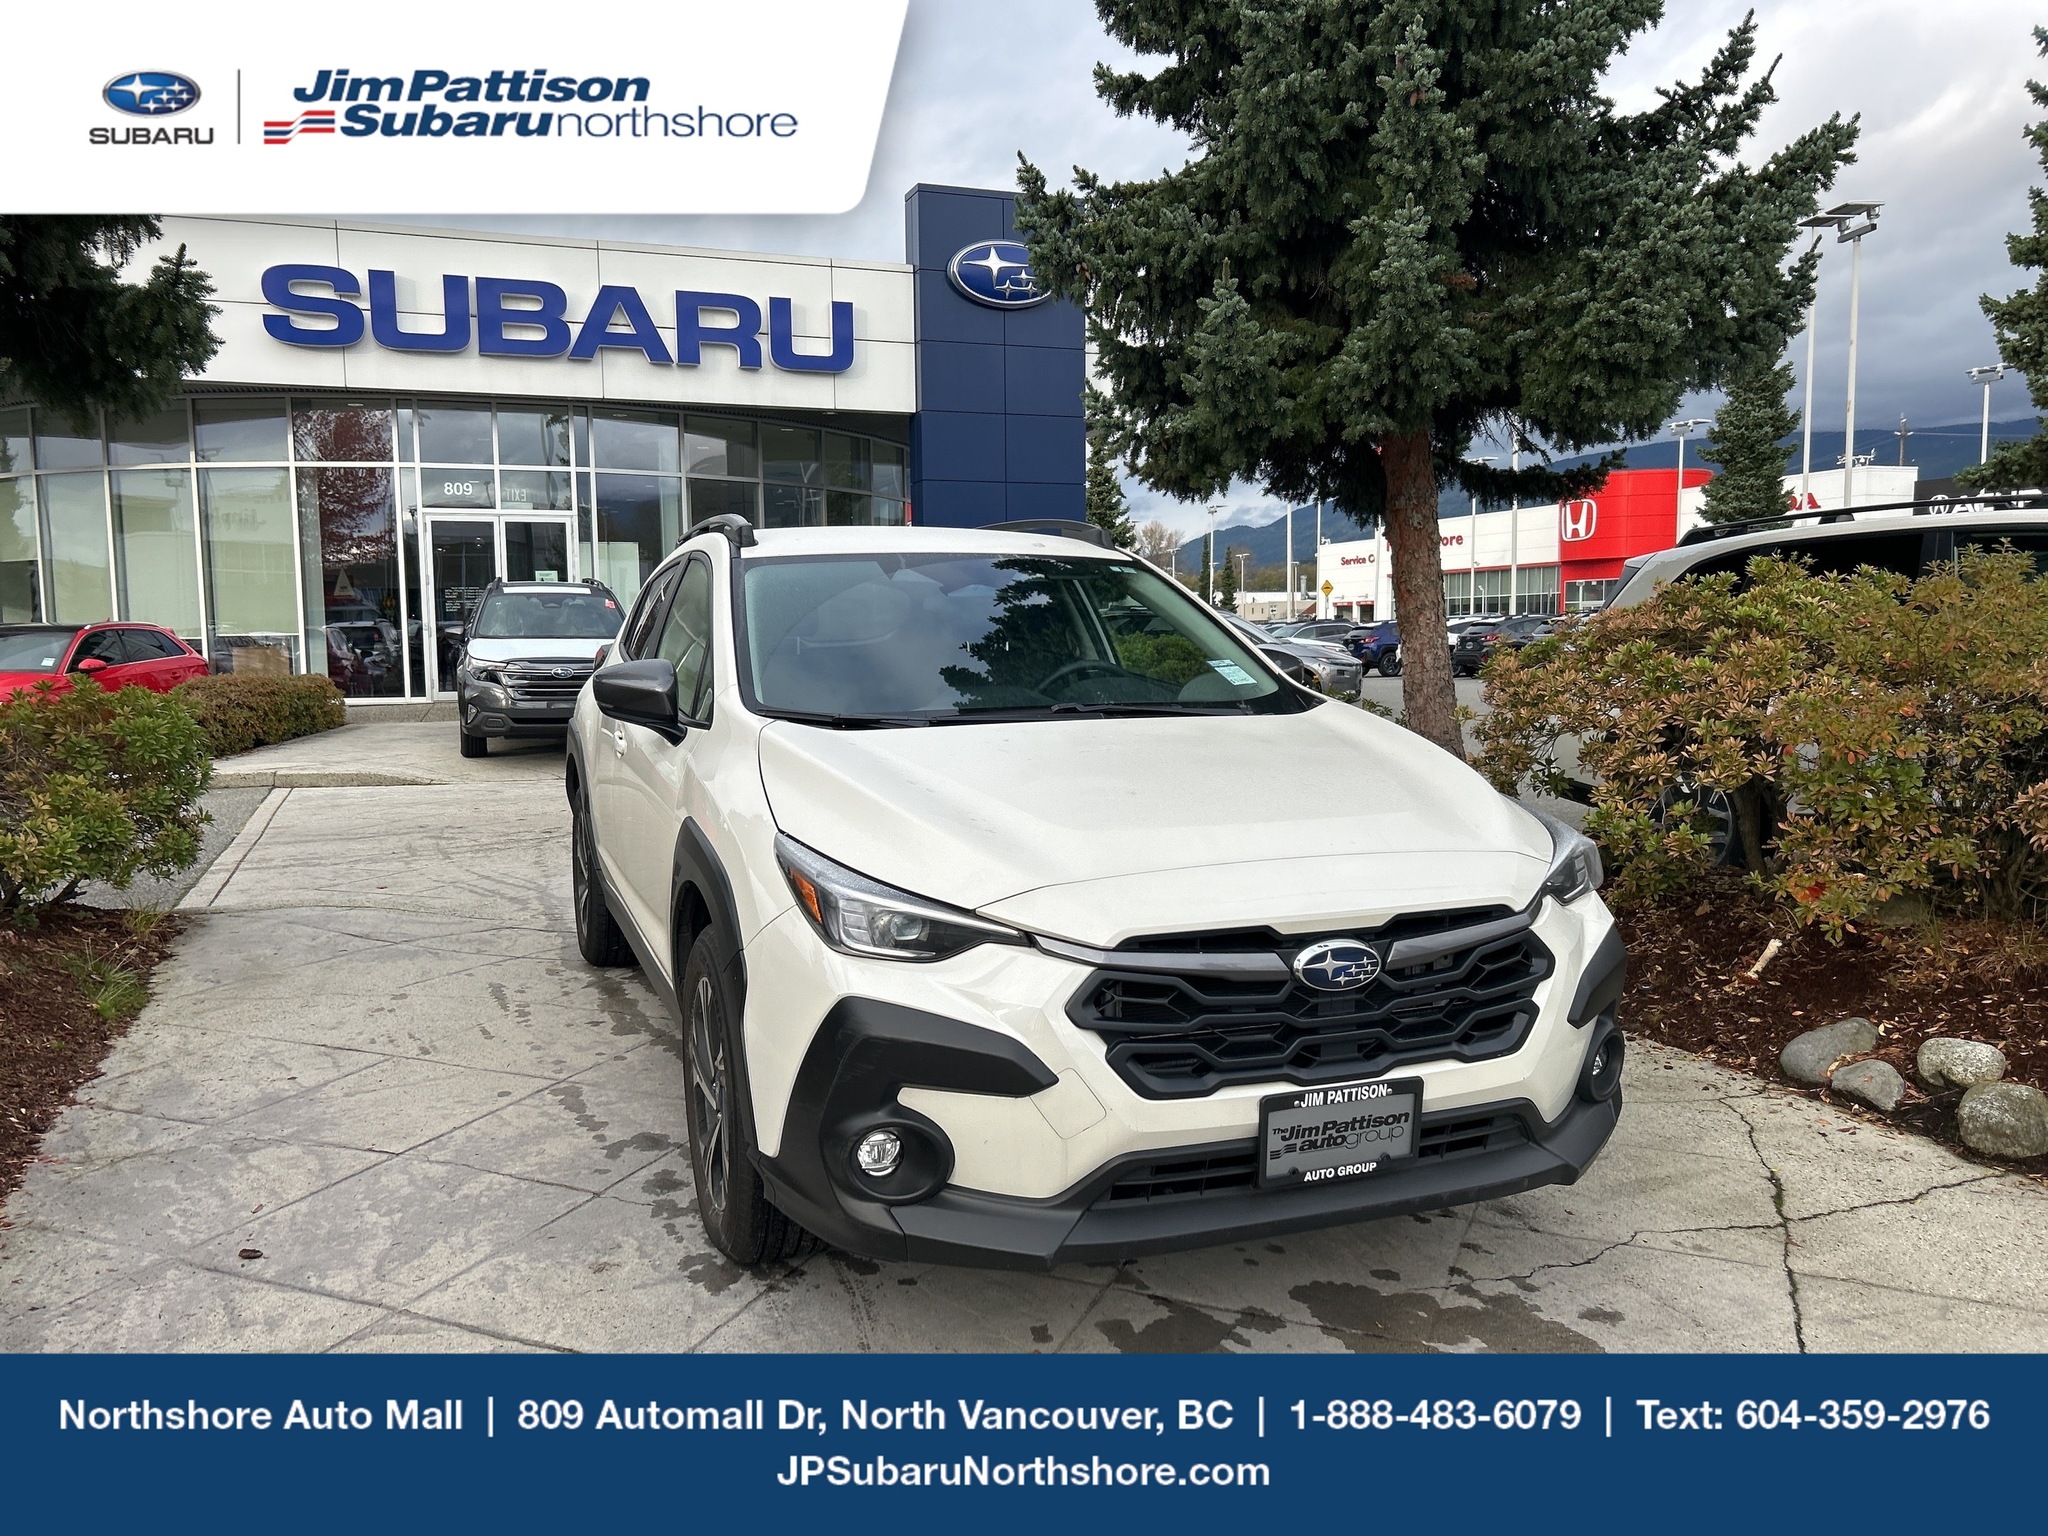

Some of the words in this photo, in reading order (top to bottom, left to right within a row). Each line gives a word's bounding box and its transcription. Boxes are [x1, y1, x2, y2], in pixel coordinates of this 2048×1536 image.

[261, 263, 855, 373] SUBARU
[444, 482, 473, 496] 809
[1341, 555, 1367, 566] Service
[1301, 1091, 1325, 1108] JIM
[1327, 1083, 1388, 1104] PATTISON
[1272, 1127, 1289, 1136] The
[1281, 1124, 1321, 1142] Jim
[1321, 1111, 1410, 1136] Pattison
[1303, 1168, 1335, 1182] AUTO
[1337, 1162, 1377, 1176] GROUP
